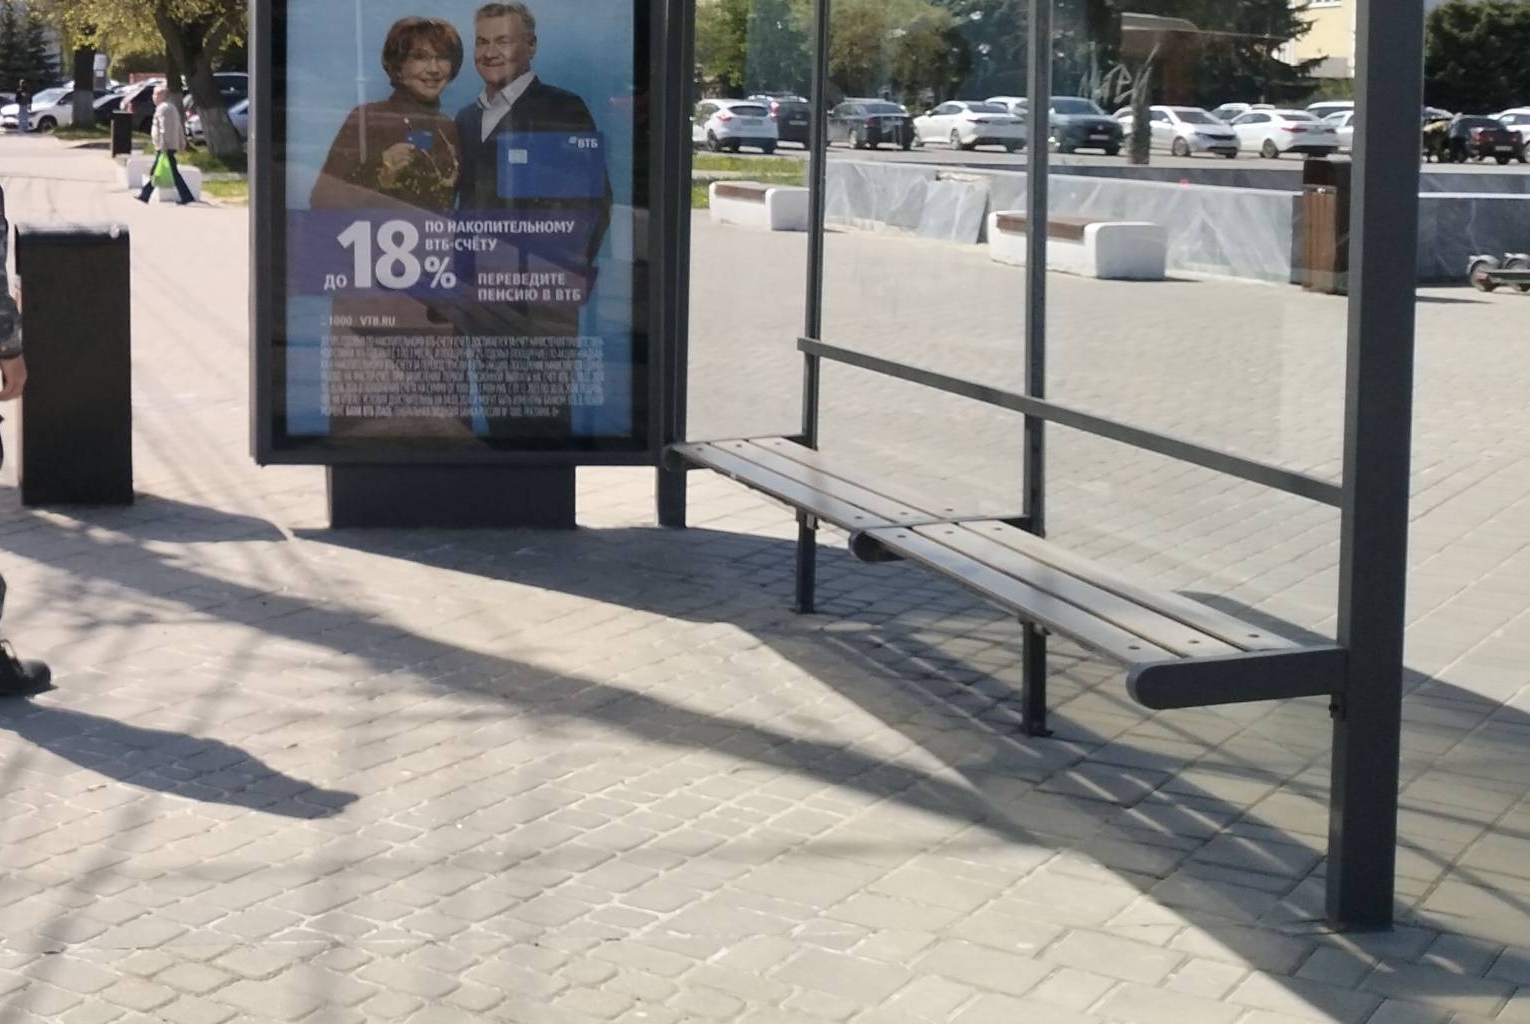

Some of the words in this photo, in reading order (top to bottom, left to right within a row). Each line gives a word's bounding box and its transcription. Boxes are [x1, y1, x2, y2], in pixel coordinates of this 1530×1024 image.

[577, 138, 599, 148] ВТБ
[425, 221, 443, 233] ПО
[447, 221, 575, 234] НАКОПИТЕЛЬНОМУ
[324, 274, 347, 290] ДО
[478, 273, 565, 288] ПЕРЕВЕДИТЕ
[478, 289, 538, 302] ПЕНСИЮ
[542, 290, 551, 301] В
[555, 290, 582, 301] ВТБ
[360, 316, 396, 326] VTB.RU
